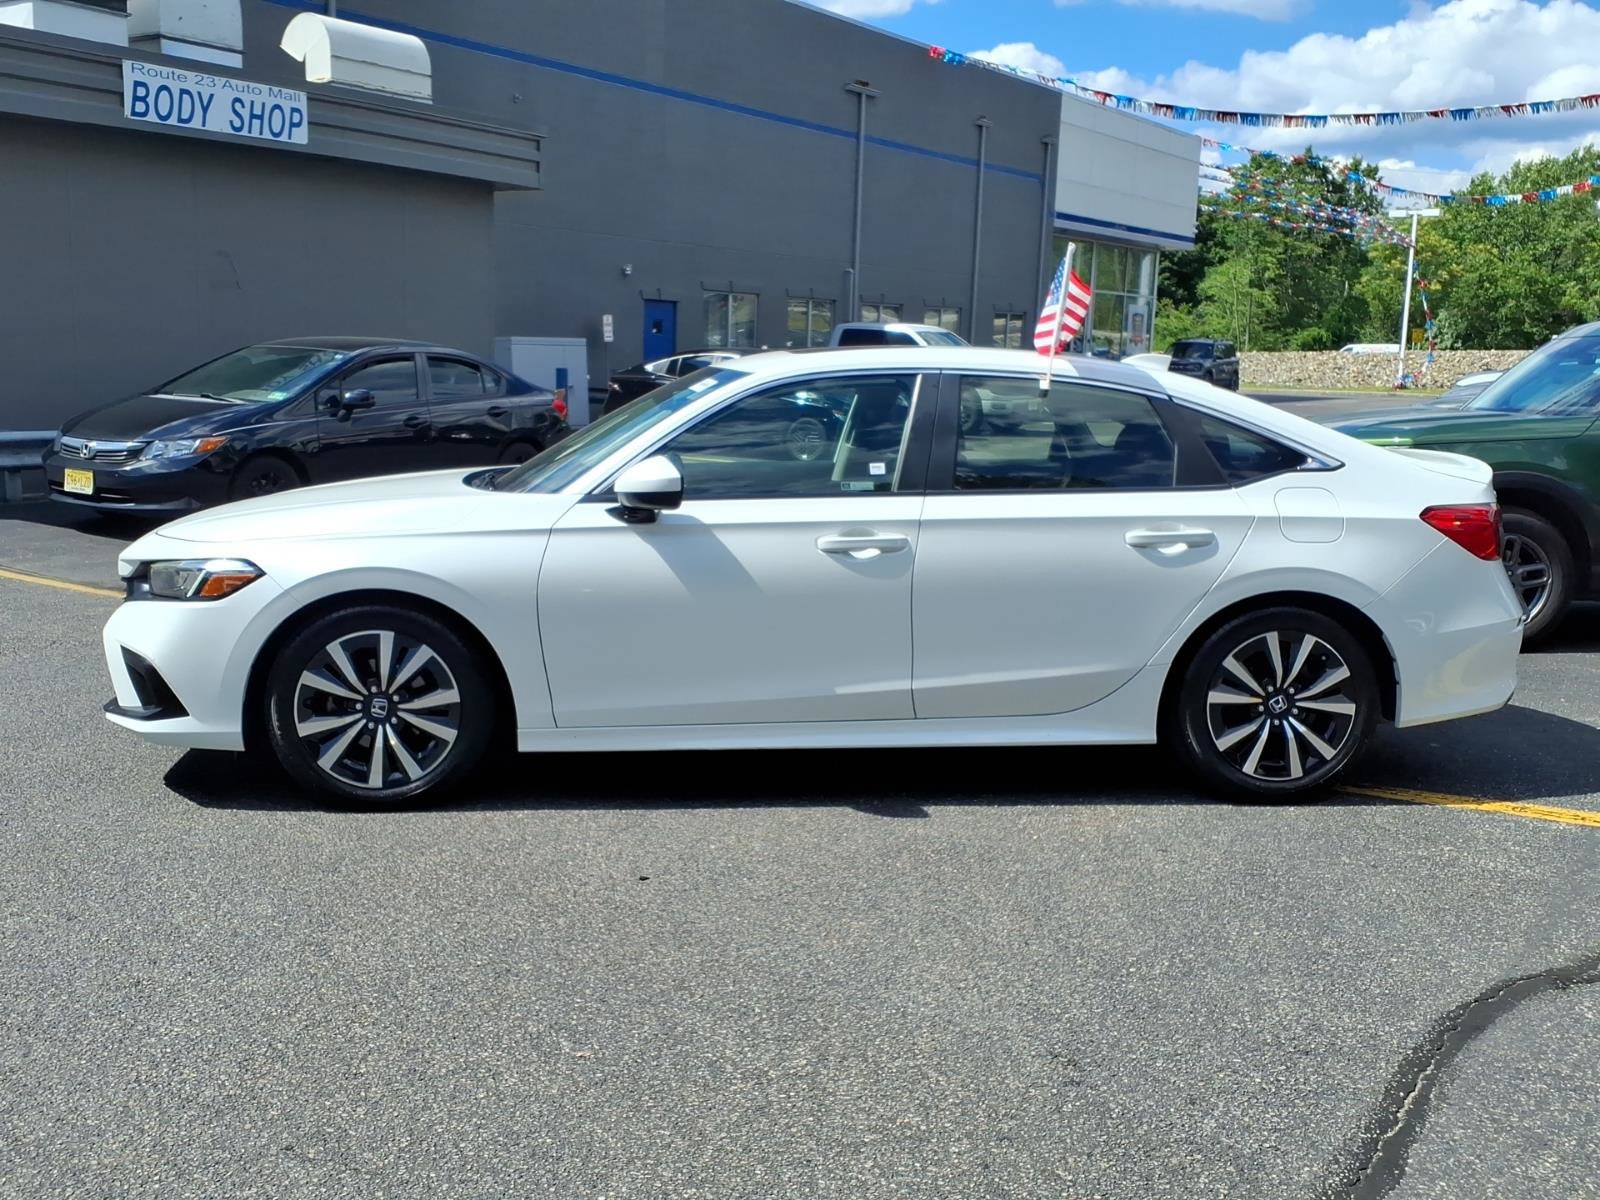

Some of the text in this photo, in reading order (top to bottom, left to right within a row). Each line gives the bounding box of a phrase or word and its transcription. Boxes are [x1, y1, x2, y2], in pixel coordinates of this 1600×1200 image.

[131, 62, 301, 103] Route 23 Auto Mall
[130, 80, 304, 141] BODY SHOP
